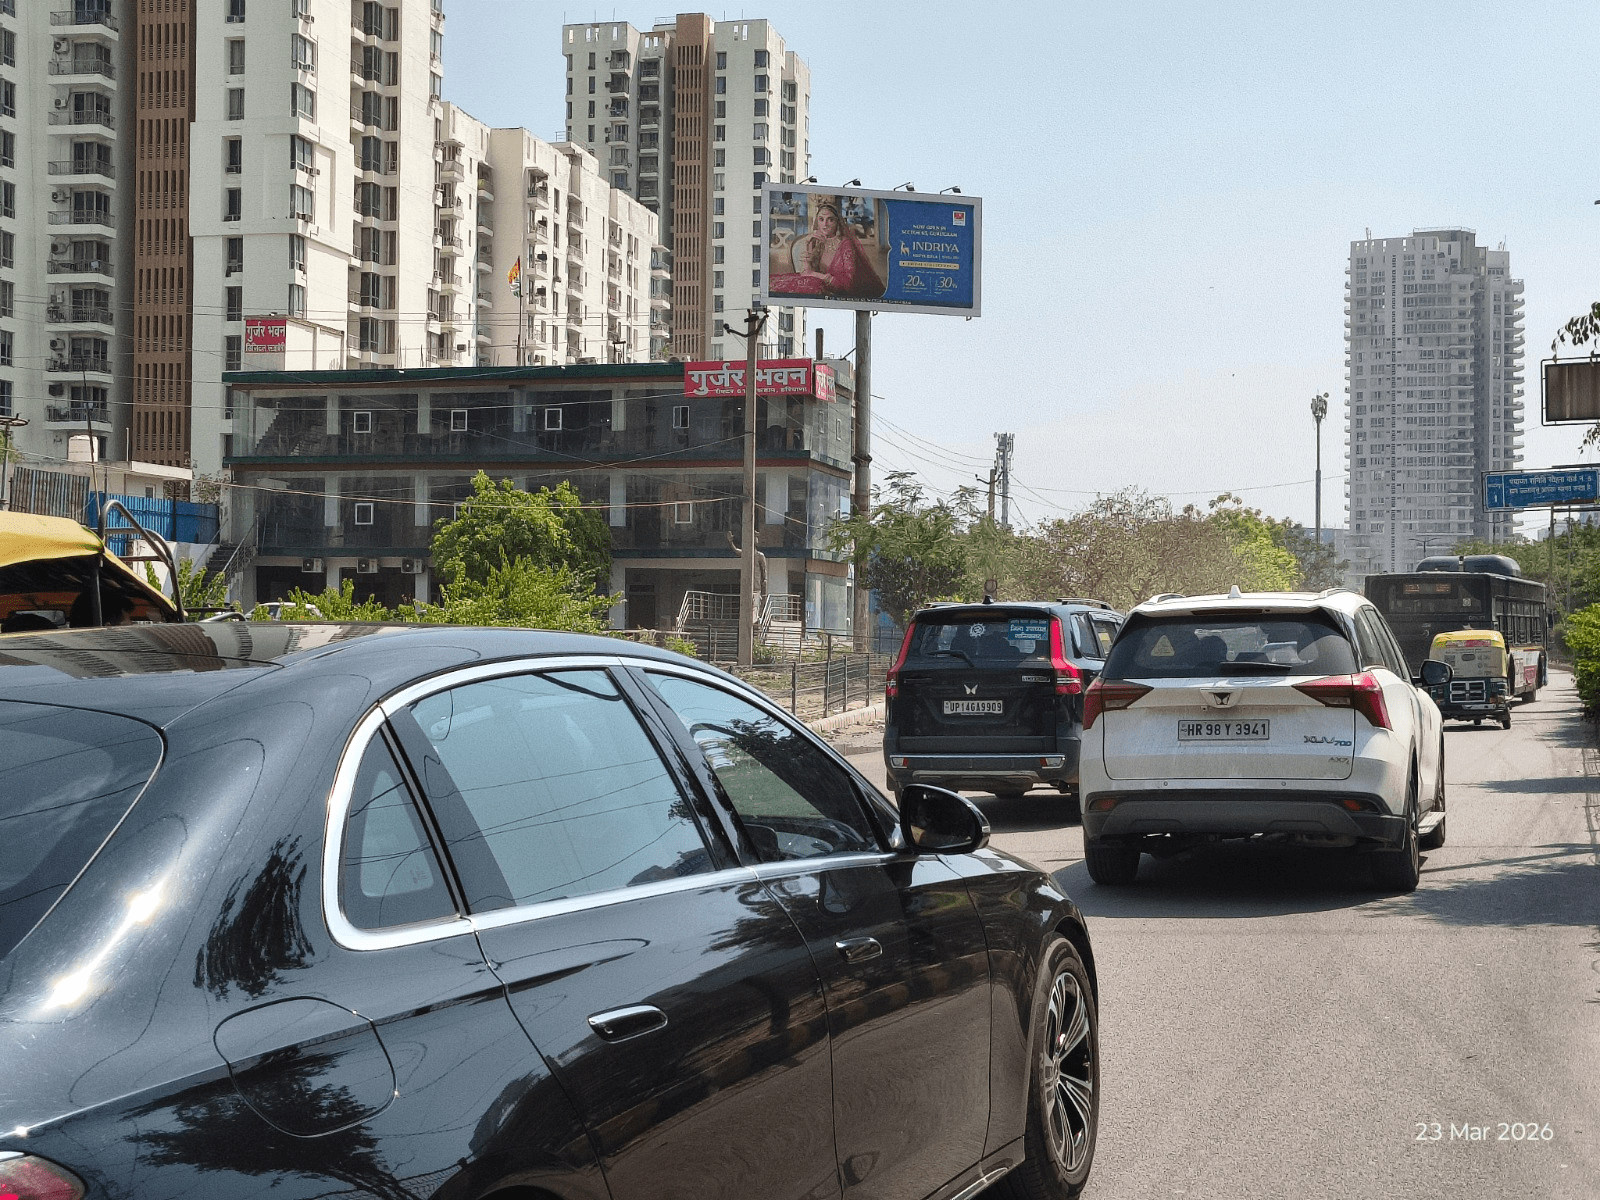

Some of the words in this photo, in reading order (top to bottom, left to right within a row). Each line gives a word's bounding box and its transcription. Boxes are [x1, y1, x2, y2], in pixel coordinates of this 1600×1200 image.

[912, 241, 959, 253] INDRIYA
[268, 325, 286, 337] भवन
[687, 363, 746, 395] गुर्जर
[756, 367, 807, 386] भवन
[950, 702, 1002, 712] UP14GA9909
[1187, 723, 1203, 736] HR
[1206, 723, 1221, 736] 98
[1225, 723, 1231, 736] Y
[1235, 723, 1266, 736] 3941
